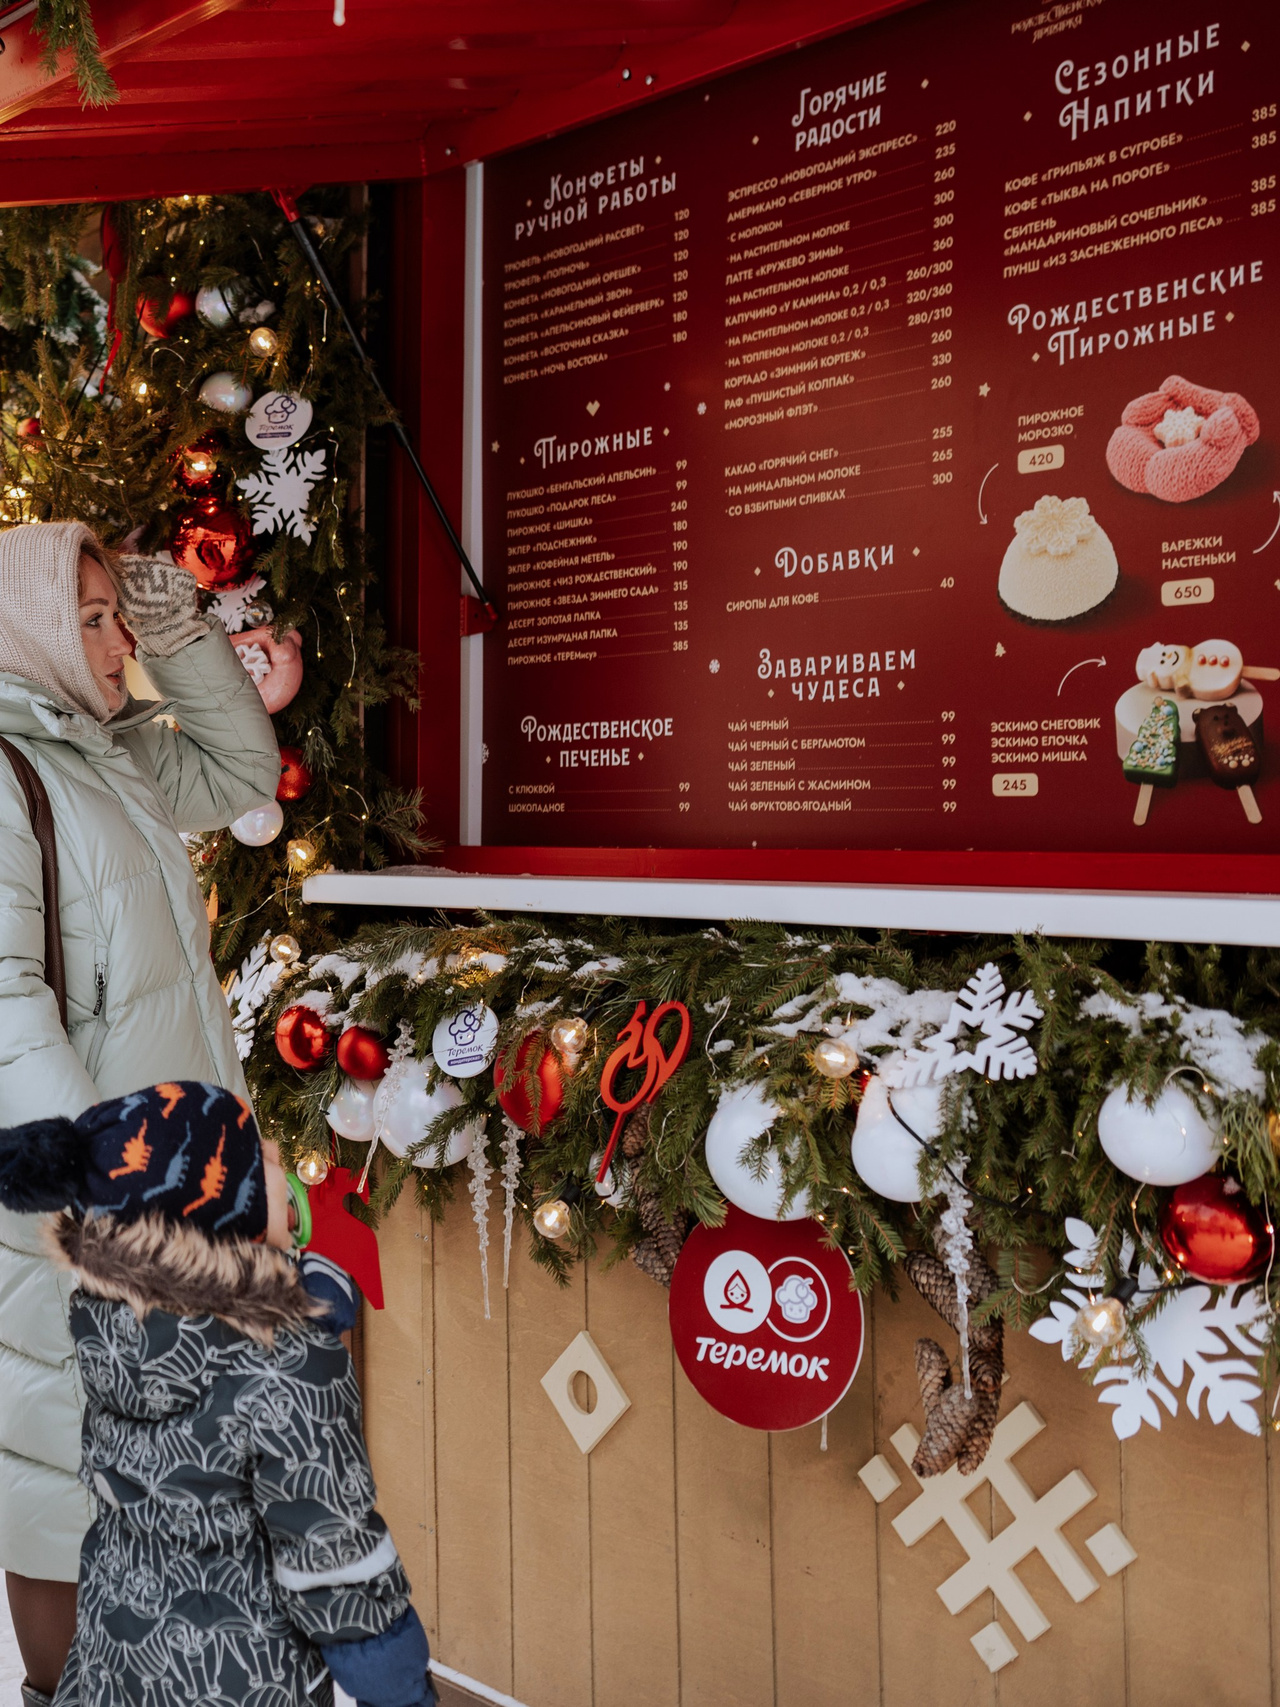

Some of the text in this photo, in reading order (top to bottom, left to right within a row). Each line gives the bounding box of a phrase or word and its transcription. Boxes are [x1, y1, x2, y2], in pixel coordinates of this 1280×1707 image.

[728, 177, 778, 202] ЭСПРЕССО
[935, 119, 956, 136] 220
[1004, 172, 1038, 192] КОФЕ
[1108, 150, 1117, 163] В
[1251, 103, 1276, 122] 385
[726, 195, 786, 223] АМЕРИКАНО
[935, 142, 955, 159] 235
[1004, 197, 1037, 216] КОФЕ
[1090, 178, 1108, 192] НА
[1251, 130, 1276, 149] 385
[1250, 174, 1276, 193] 385
[1003, 217, 1056, 240] СБИТЕНЬ
[1003, 259, 1040, 278] ПУНШ
[1070, 225, 1176, 262] ЗАСНЕЖЕННОГО
[1250, 198, 1276, 216] 385
[504, 274, 540, 290] ТРЮФЕЛЬ
[674, 228, 689, 241] 120
[725, 268, 753, 285] ЛАТТЕ
[933, 212, 954, 228] 300
[503, 350, 538, 365] КОНФЕТА
[672, 310, 688, 322] 180
[503, 369, 538, 384] КОНФЕТА
[672, 330, 687, 343] 180
[724, 370, 767, 389] КОРТАДО
[931, 328, 952, 344] 260
[724, 396, 743, 410] РАФ
[932, 352, 952, 366] 330
[930, 375, 952, 389] 260
[1018, 404, 1084, 426] ПИРОЖНОЕ
[1017, 423, 1073, 443] МОРОЗКО
[724, 461, 756, 477] КАКАО
[932, 425, 952, 439] 255
[1029, 452, 1054, 466] 420
[507, 505, 544, 518] ЛУКОШКО
[676, 479, 687, 491] 99
[507, 522, 550, 537] ПИРОЖНОЕ
[670, 499, 687, 512] 240
[508, 563, 530, 574] ЭКЛЕР
[672, 540, 688, 551] 190
[1161, 535, 1222, 553] ВАРЕЖКИ
[1162, 551, 1236, 569] НАСТЕНЬКИ
[507, 578, 550, 591] ПИРОЖНОЕ
[672, 559, 688, 571] 190
[508, 597, 550, 609] ПИРОЖНОЕ
[590, 587, 628, 601] ЗИМНЕГО
[673, 579, 688, 591] 315
[726, 576, 954, 612] СИРОПЫ ДЛЯ КОФЕ 40
[1174, 585, 1202, 599] 650
[507, 600, 688, 630] ДЕСЕРТ ЗОЛОТАЯ ЛАПКА 135
[507, 619, 688, 648] ДЕСЕРТ ИЗУМРУДНАЯ ЛАПКА 135
[507, 653, 551, 665] ПИРОЖНОЕ
[672, 640, 688, 651] 385
[727, 710, 955, 732] ЧАЙ ЧЕРНЫЙ 99
[990, 717, 1100, 732] ЭСКИМО СНЕГОВИК
[728, 733, 956, 751] ЧАЙ ЧЕРНЫЙ С БЕРГАМОТОМ 99
[990, 734, 1088, 748] ЭСКИМО ЕЛОЧКА
[991, 750, 1087, 763] ЭСКИМО МИШКА
[508, 781, 690, 794] С КЛЮКВОЙ 99
[728, 778, 956, 791] ЧАЙ ЗЕЛЕНЫЙ С ЖАСМИНОМ 99
[1002, 779, 1027, 791] 245
[508, 801, 690, 813] ШОКОЛАДНОЕ 99
[728, 799, 747, 811] ЧАЙ
[942, 801, 956, 812] 99
[695, 1336, 830, 1382] Теремок
